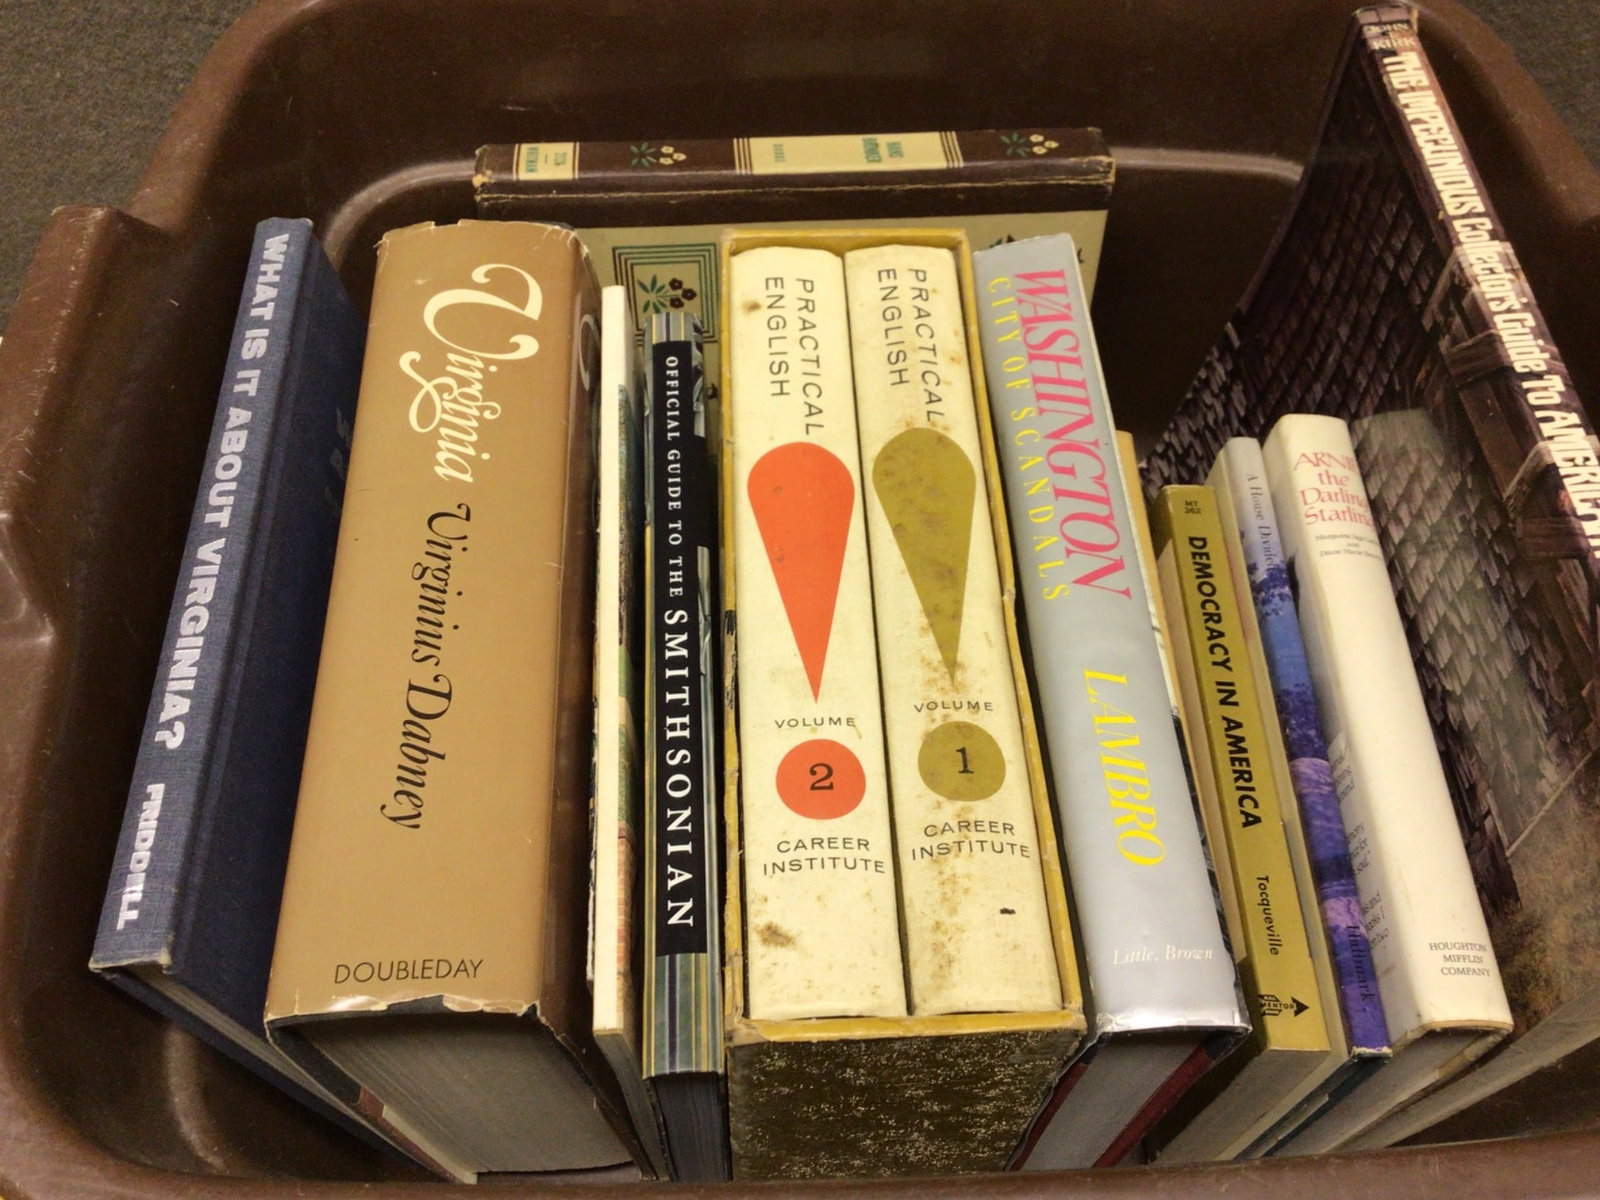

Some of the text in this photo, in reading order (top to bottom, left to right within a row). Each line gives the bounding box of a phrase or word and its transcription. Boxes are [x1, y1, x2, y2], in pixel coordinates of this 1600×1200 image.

[1370, 37, 1417, 51] KIRK
[764, 276, 793, 398] ENGLISH
[876, 267, 911, 387] ENGLISH
[907, 267, 946, 423] PRACTICAL
[398, 262, 544, 484] Virginia
[796, 276, 826, 437] PRACTICAL
[986, 276, 1072, 602] CITY OF SCANDALS
[1013, 268, 1134, 602] WASHINGTON
[154, 234, 290, 750] WHAT IS IT ABOUT VIRGINIA?
[664, 355, 684, 599] OFFICIAL GUIDE TO THE
[1318, 469, 1350, 486] the
[380, 502, 471, 831] Virginius Dabney
[1188, 536, 1262, 828] DEMOCRACY IN AMERICA
[774, 715, 857, 730] VOLUME
[913, 699, 995, 714] VOLUME
[663, 608, 696, 928] SMITHSONIAN
[808, 762, 836, 792] 2
[955, 746, 976, 775] 1
[1083, 668, 1168, 866] LAMBRO
[776, 836, 871, 855] CAREER
[911, 838, 1032, 861] INSTITUTE
[923, 819, 1016, 838] CAREER
[763, 855, 886, 876] INSTITUTE
[1256, 875, 1283, 955] Tocqueville
[334, 958, 486, 986] DOUBLEDAY
[1113, 944, 1214, 966] Little, Brown
[1428, 941, 1488, 953] HOUGHTON
[1440, 966, 1490, 977] COMPANY
